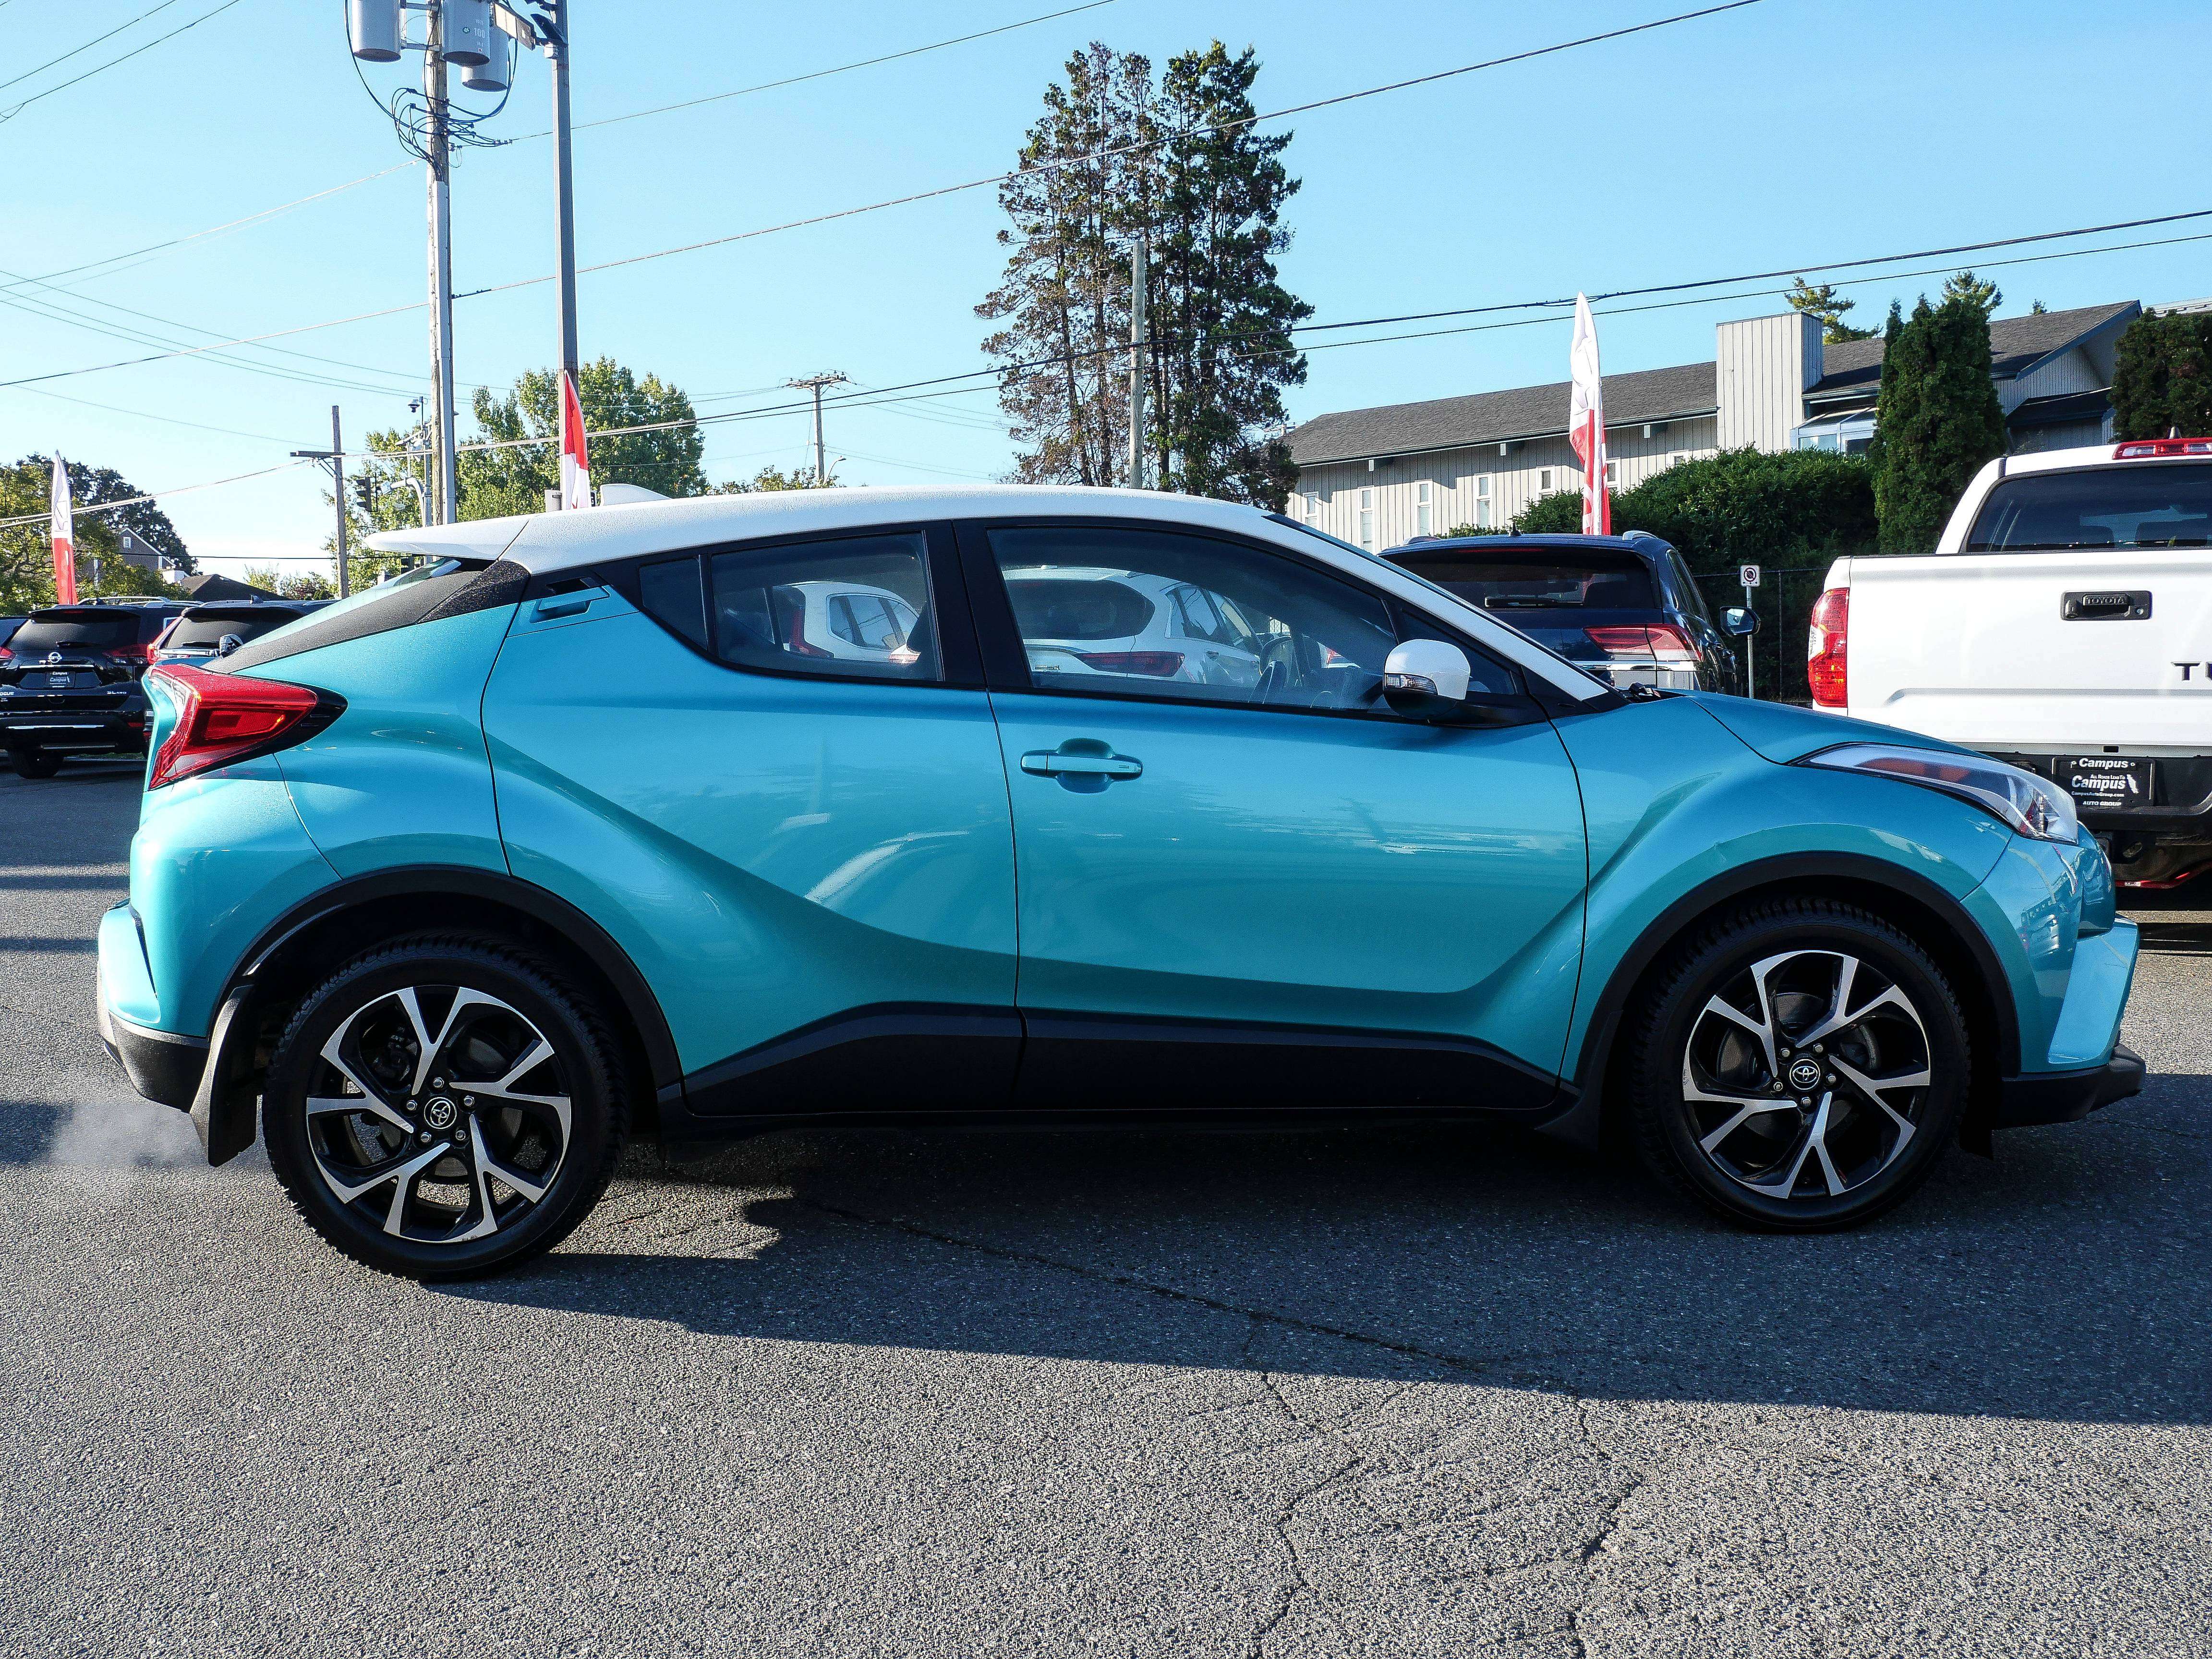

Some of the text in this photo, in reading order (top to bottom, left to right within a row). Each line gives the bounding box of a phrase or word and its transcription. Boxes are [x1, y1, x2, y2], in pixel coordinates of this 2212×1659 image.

[2171, 662, 2212, 681] T
[2079, 758, 2128, 770] Campus
[2072, 775, 2126, 791] Campus
